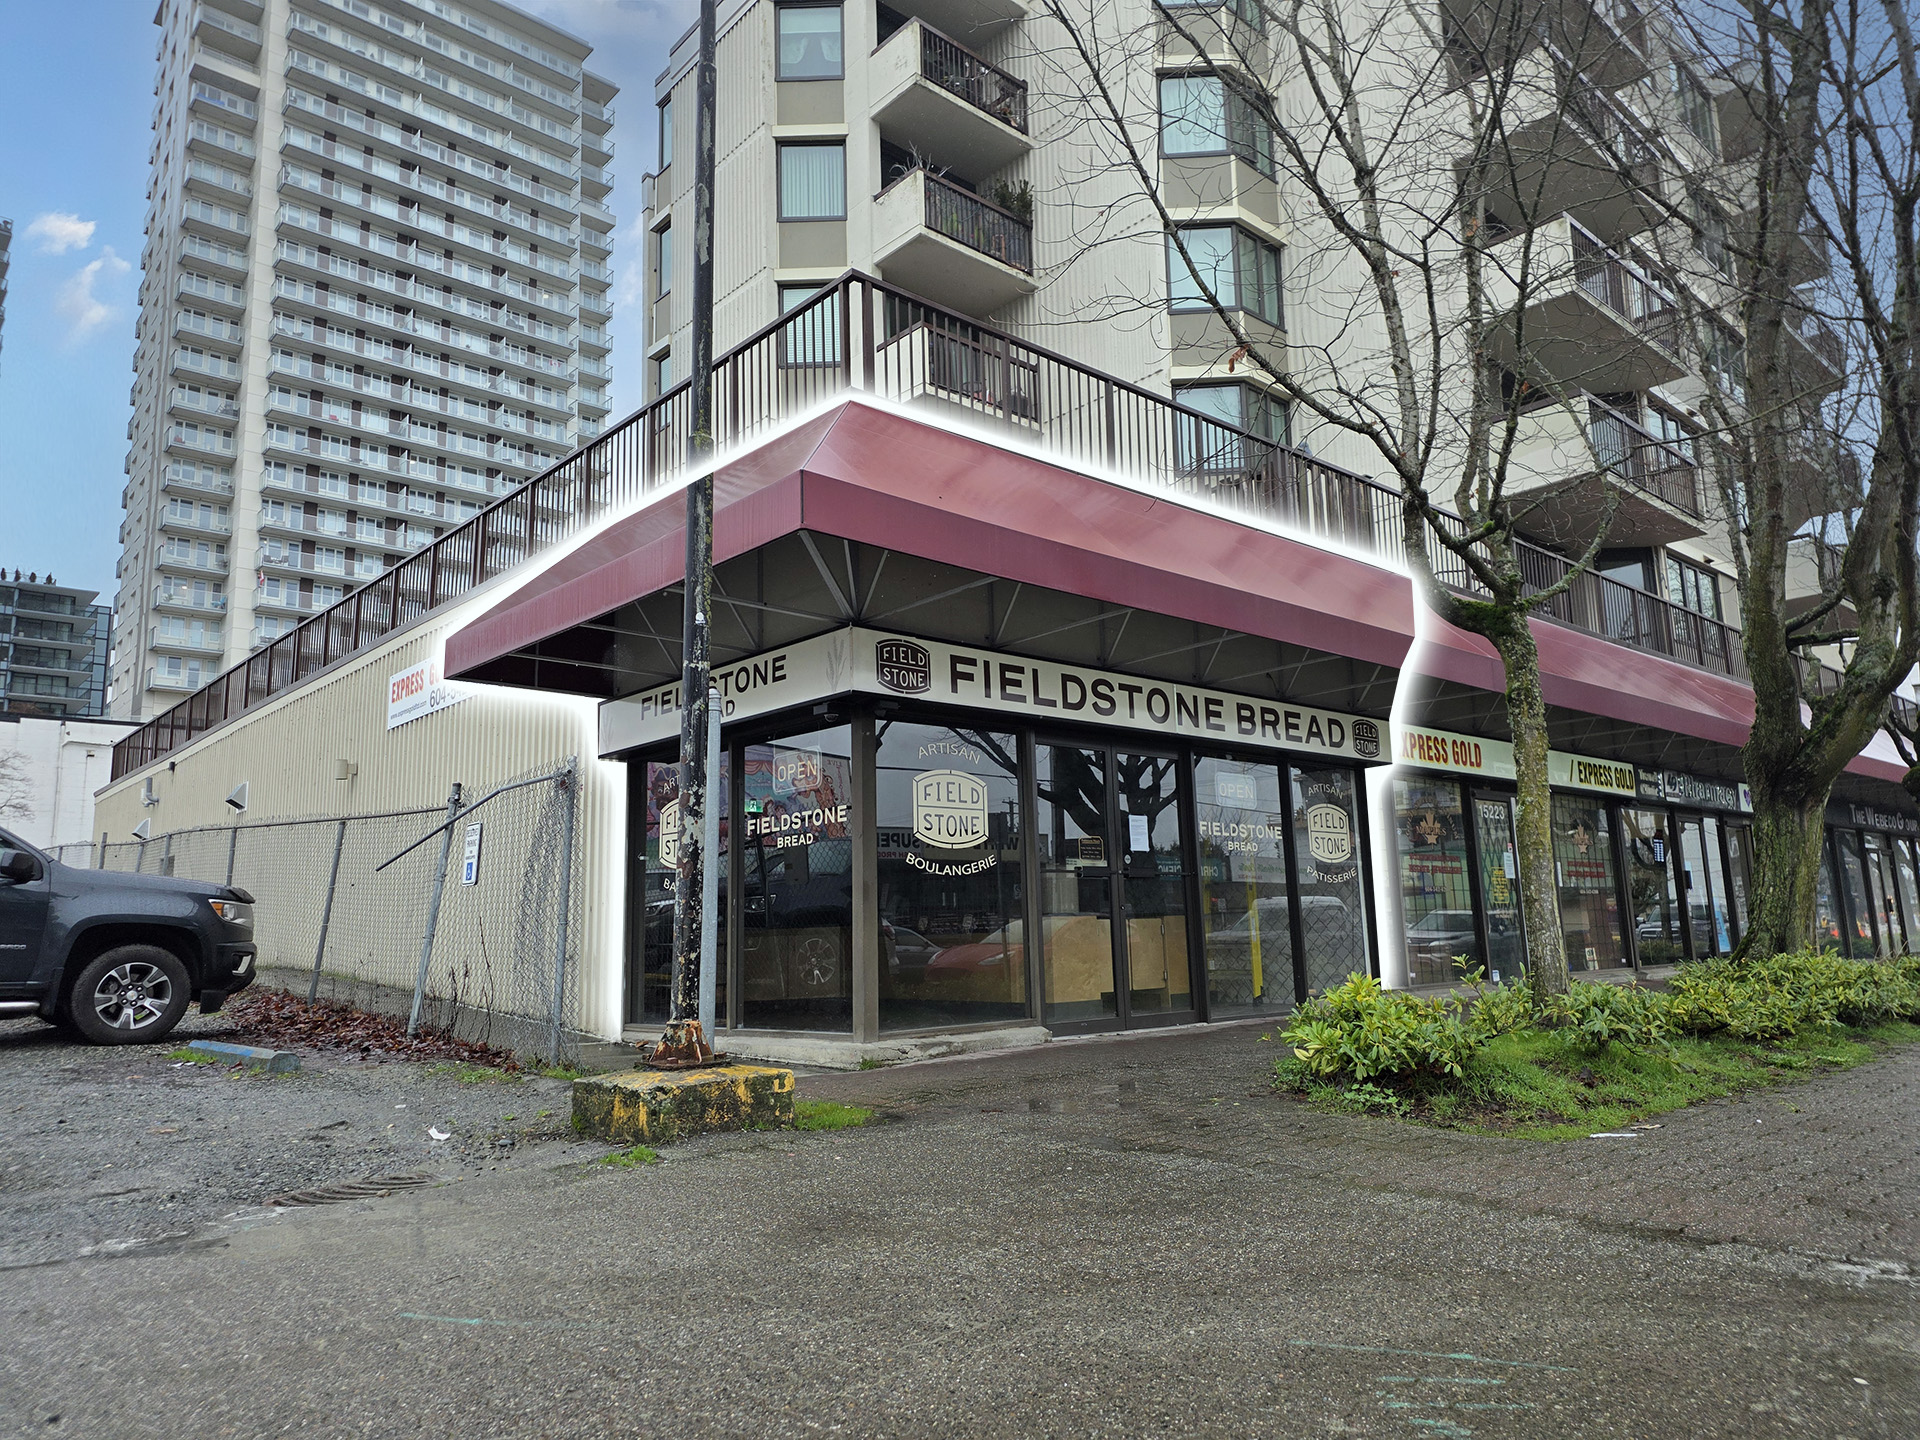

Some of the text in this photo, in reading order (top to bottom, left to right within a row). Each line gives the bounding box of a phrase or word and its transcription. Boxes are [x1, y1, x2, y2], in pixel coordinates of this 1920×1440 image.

[883, 647, 925, 666] FIELD
[391, 668, 425, 703] EXPRESS
[641, 654, 787, 720] FIELTONE
[883, 667, 925, 688] STONE
[950, 654, 1345, 748] FIELDSTONE BREAD
[1355, 724, 1377, 738] FIELD
[917, 742, 981, 765] ARTISAN
[1356, 739, 1377, 753] STONE
[1401, 731, 1482, 768] XPRESS GOLD
[777, 758, 817, 783] OPEN
[1577, 760, 1614, 788] EXPRESS
[1614, 766, 1634, 790] GOLD
[923, 782, 981, 805] FIELD
[1219, 782, 1254, 799] OPEN
[1308, 783, 1344, 799] ARTISAN
[747, 804, 848, 836] FIELDSTONE
[1313, 812, 1345, 830] FIELD
[1479, 804, 1505, 819] 15223
[923, 813, 980, 838] STONE
[1199, 820, 1283, 840] FIELDSTONE
[777, 833, 814, 849] BREAD
[1227, 841, 1259, 852] BREAD
[1314, 836, 1346, 855] STONE
[905, 852, 997, 876] BOULANGERIE
[1306, 865, 1358, 883] PATISSERIE
